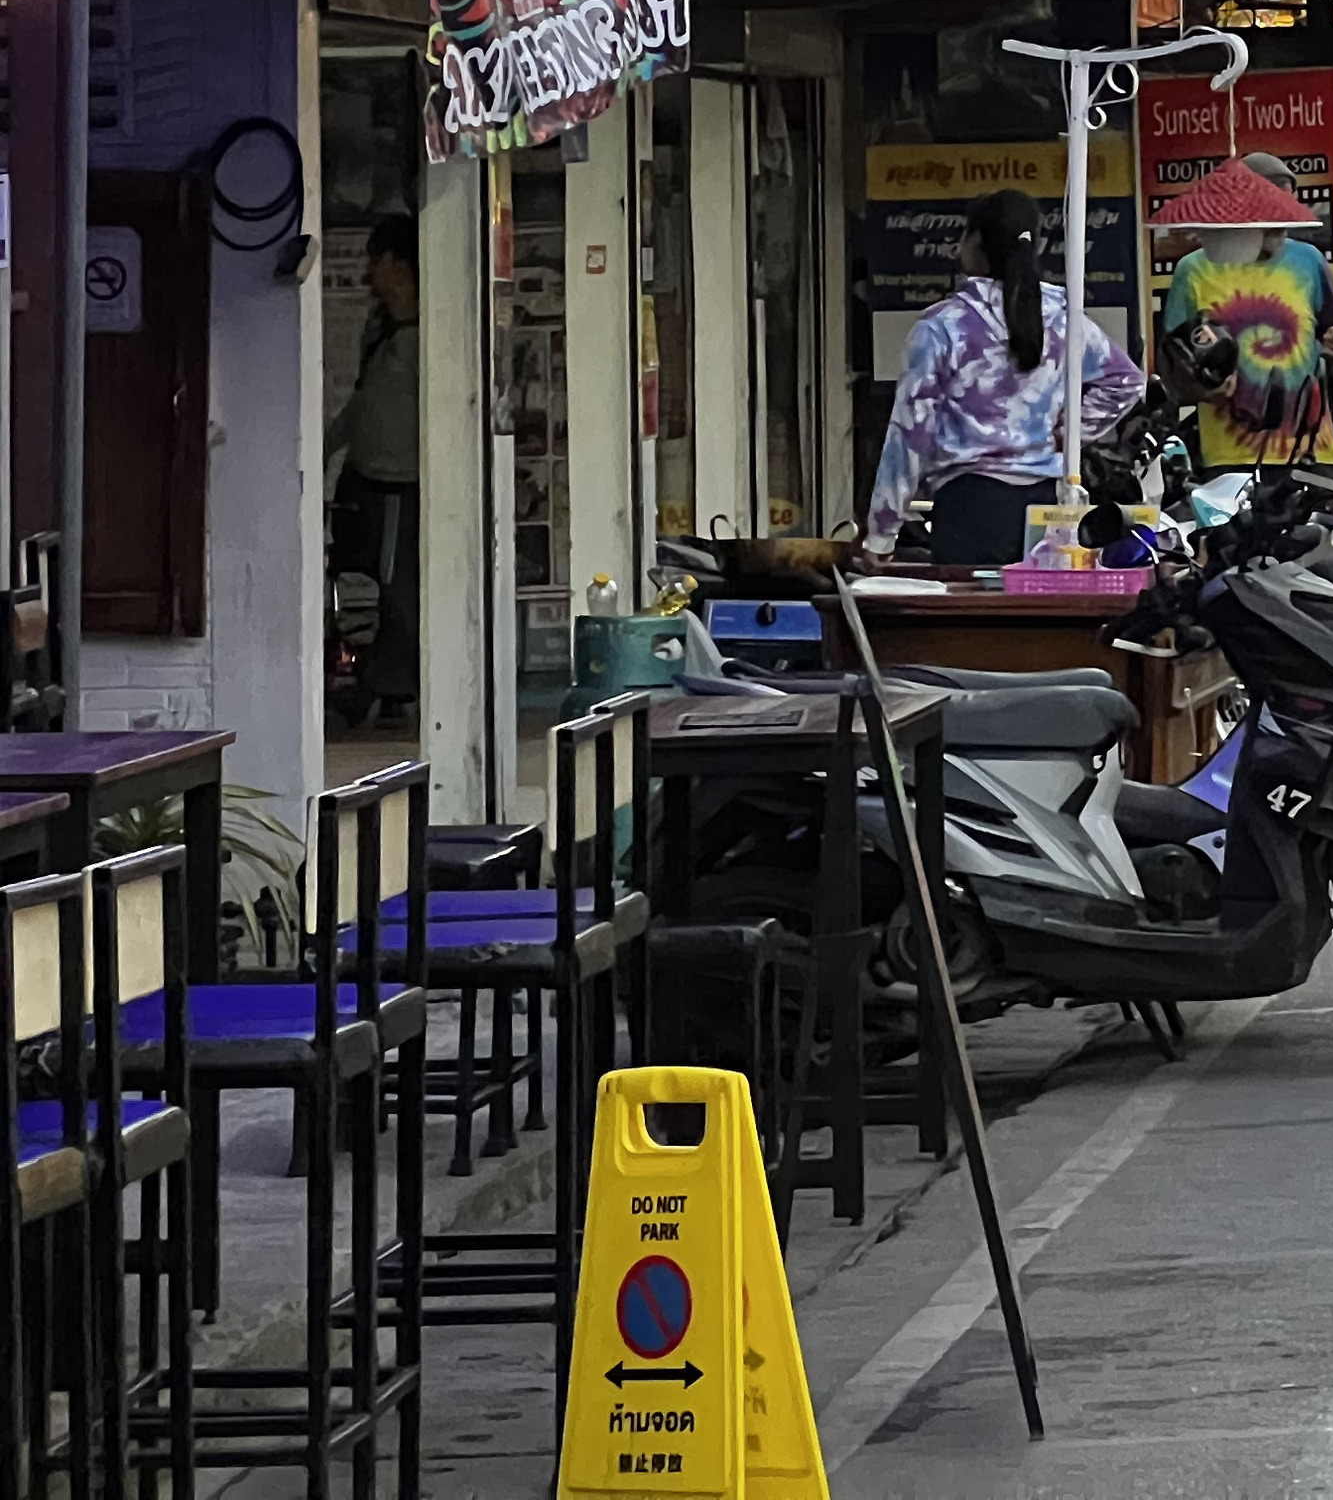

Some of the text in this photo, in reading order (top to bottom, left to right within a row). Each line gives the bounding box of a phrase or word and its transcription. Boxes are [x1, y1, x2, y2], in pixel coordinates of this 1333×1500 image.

[1153, 101, 1219, 137] Sunset
[1243, 96, 1285, 131] Two
[1289, 92, 1325, 128] Hut
[1157, 161, 1193, 182] 100
[1266, 784, 1312, 820] 47
[632, 1196, 688, 1214] DO NOT
[640, 1222, 679, 1241] PARK
[609, 1402, 695, 1433] ห้ามจอด
